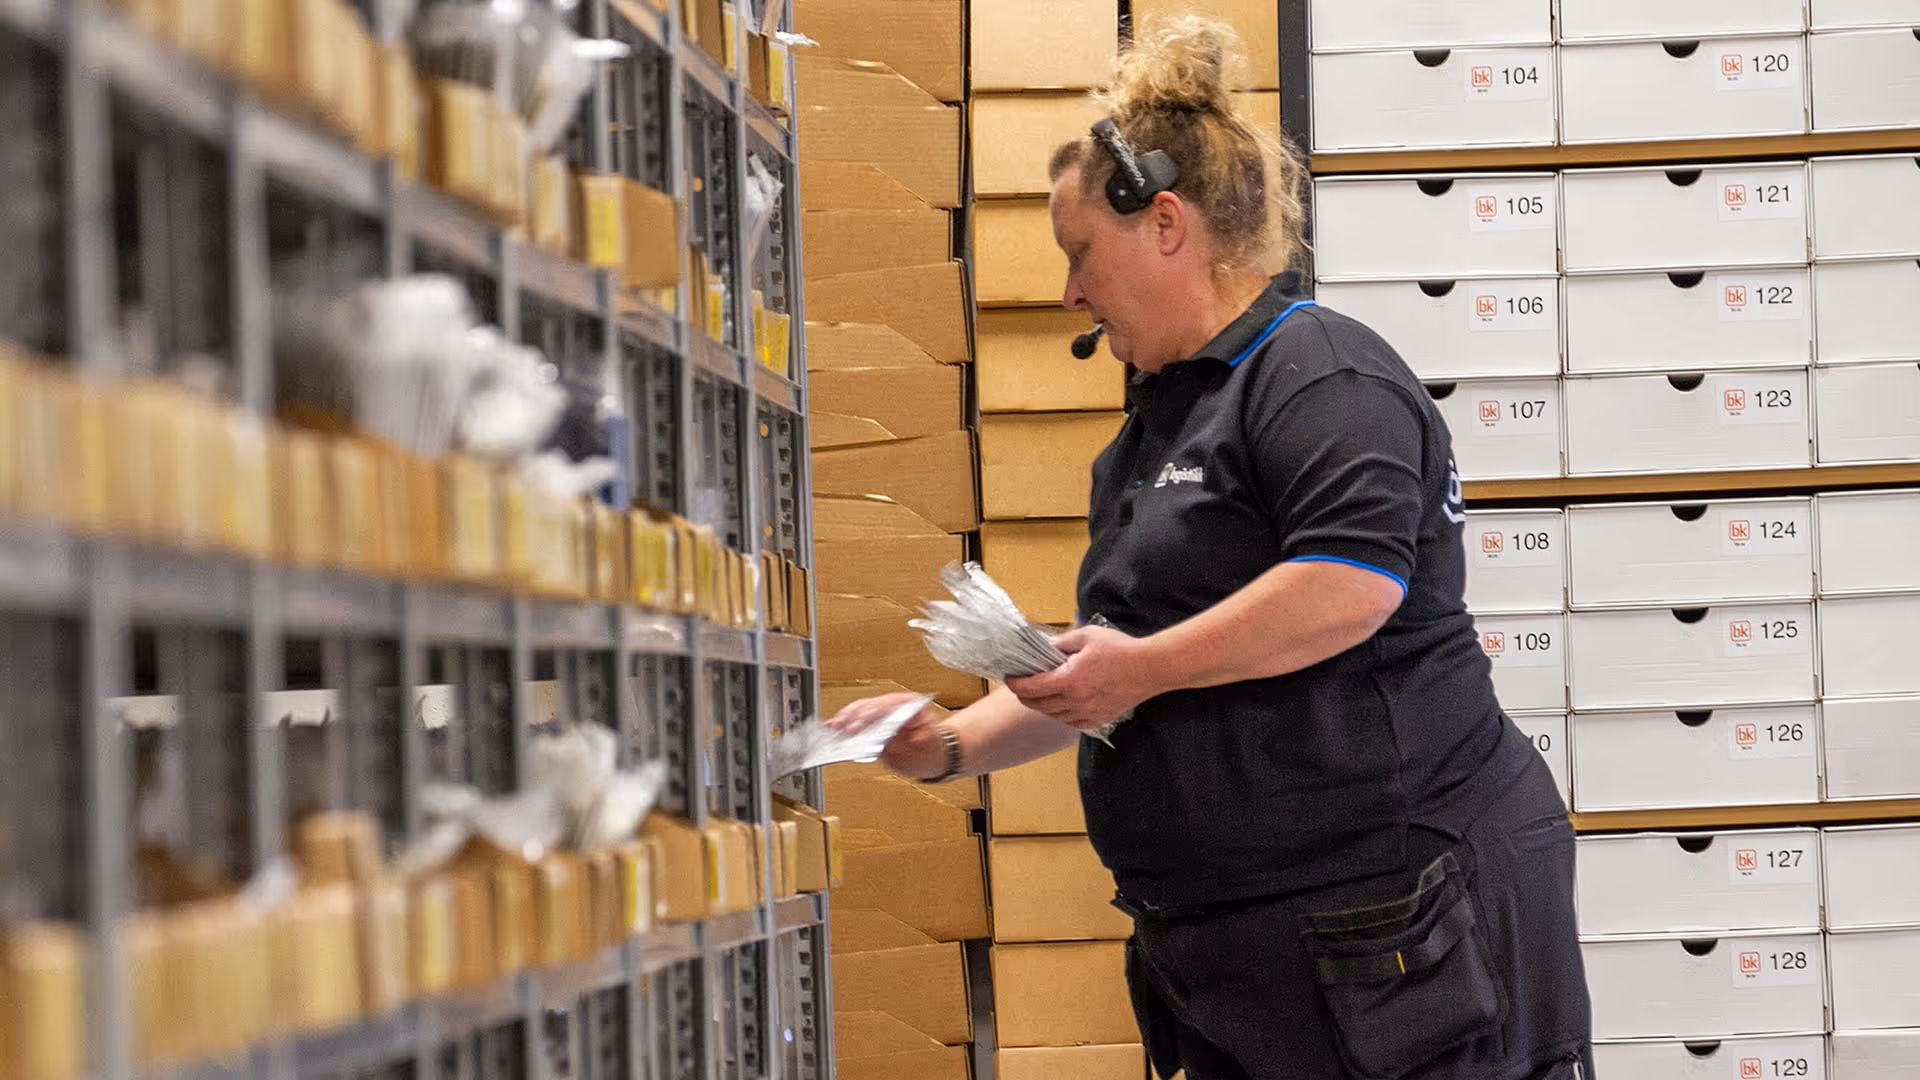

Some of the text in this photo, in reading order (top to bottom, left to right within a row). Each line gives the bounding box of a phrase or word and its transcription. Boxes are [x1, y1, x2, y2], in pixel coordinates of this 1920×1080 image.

[1724, 54, 1789, 73] bk 120
[1474, 66, 1538, 85] bk 104
[1727, 185, 1789, 203] bk 121
[1478, 196, 1543, 215] bk 105
[1728, 286, 1793, 305] bk 122
[1479, 296, 1544, 315] bk 106
[1726, 389, 1792, 408] bk 123
[1481, 400, 1546, 419] bk 107
[1732, 520, 1797, 539] bk 124
[1484, 532, 1550, 551] bk 108
[1733, 620, 1798, 639] bk 125
[1486, 632, 1551, 651] bk 109
[1738, 723, 1804, 742] bk 126
[1738, 849, 1804, 868] bk 127
[1742, 951, 1807, 970] bk 128
[1743, 1058, 1808, 1077] bk 129
